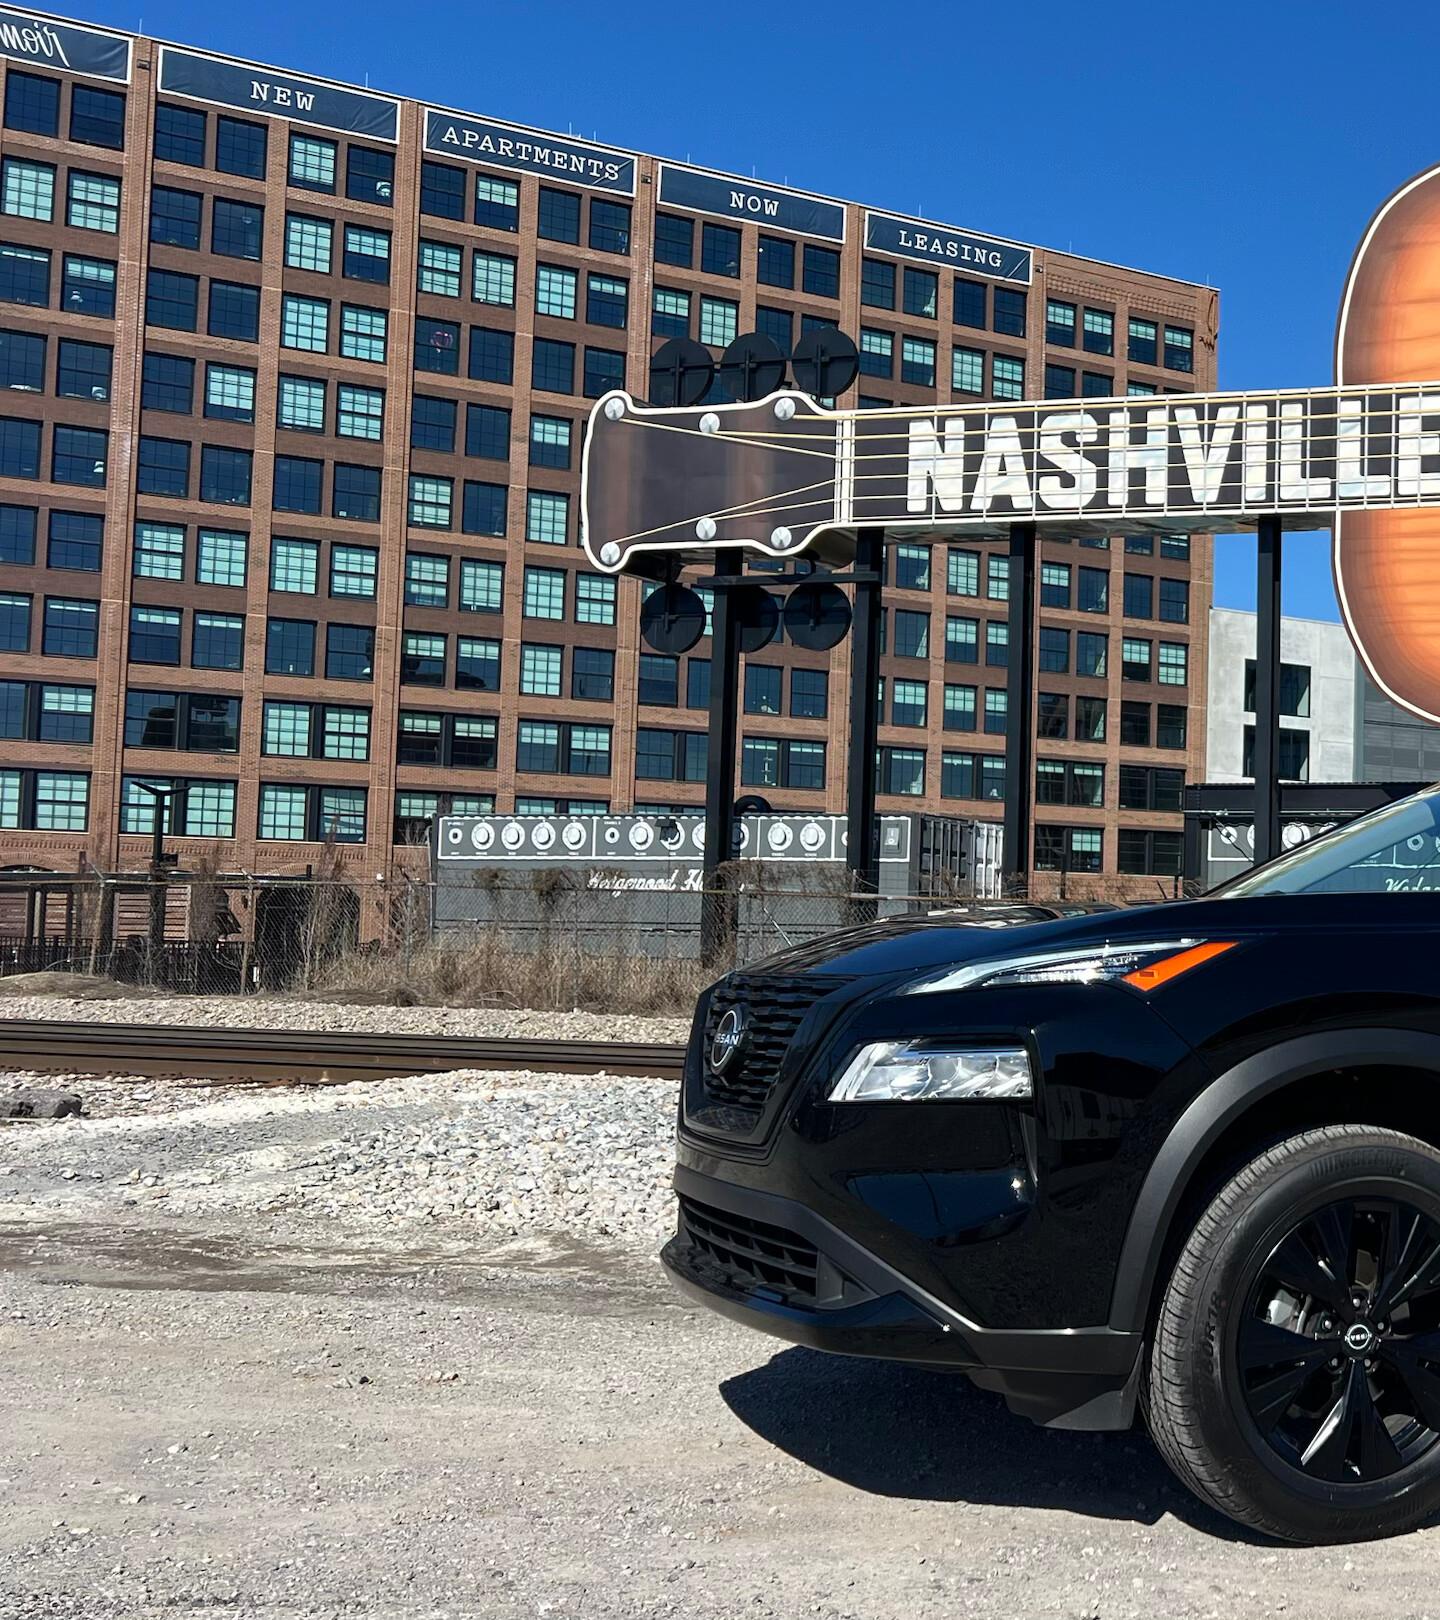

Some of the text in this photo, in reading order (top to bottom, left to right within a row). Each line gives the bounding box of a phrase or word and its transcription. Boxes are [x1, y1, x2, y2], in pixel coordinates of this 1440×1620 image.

[250, 80, 315, 112] NEW
[441, 125, 620, 182] APARTMENTS
[729, 191, 779, 218] NOW
[898, 230, 1003, 268] LEASING
